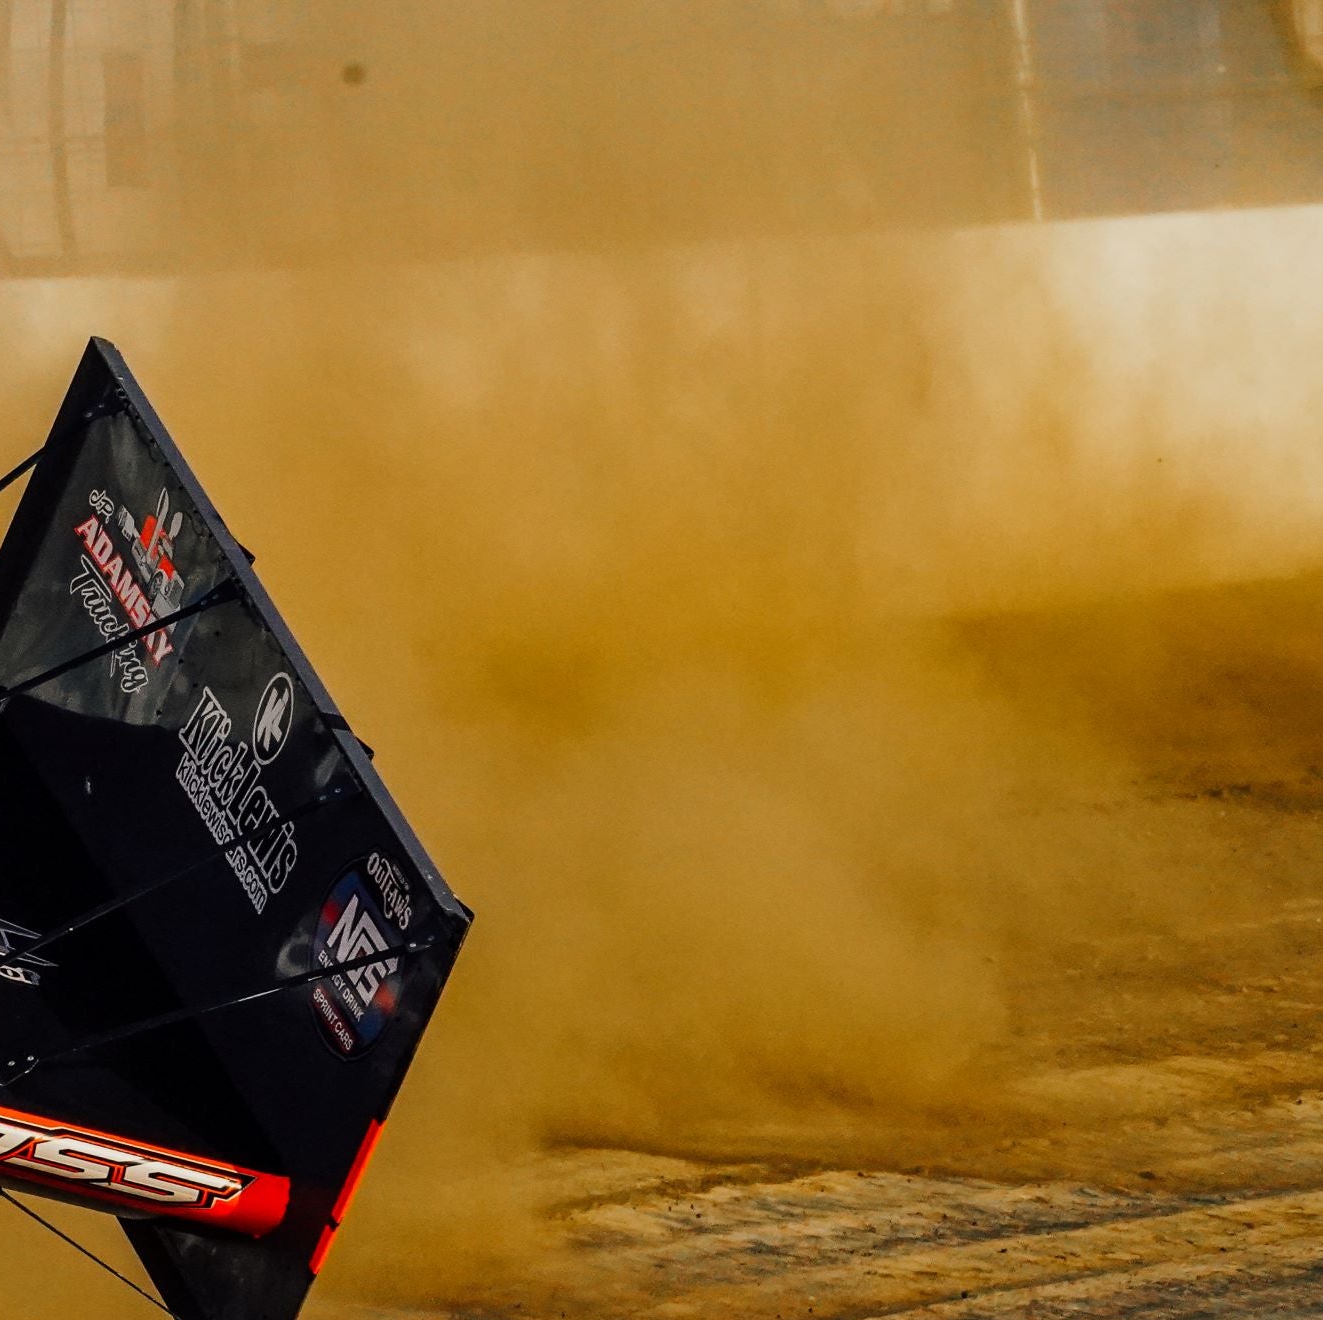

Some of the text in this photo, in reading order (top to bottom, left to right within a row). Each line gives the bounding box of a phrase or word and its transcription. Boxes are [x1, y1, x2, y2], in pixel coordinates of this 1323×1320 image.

[366, 851, 413, 931] OUTLAWS
[312, 987, 353, 1052] SPRINT CARS
[317, 949, 366, 1023] ENRGY DRINK
